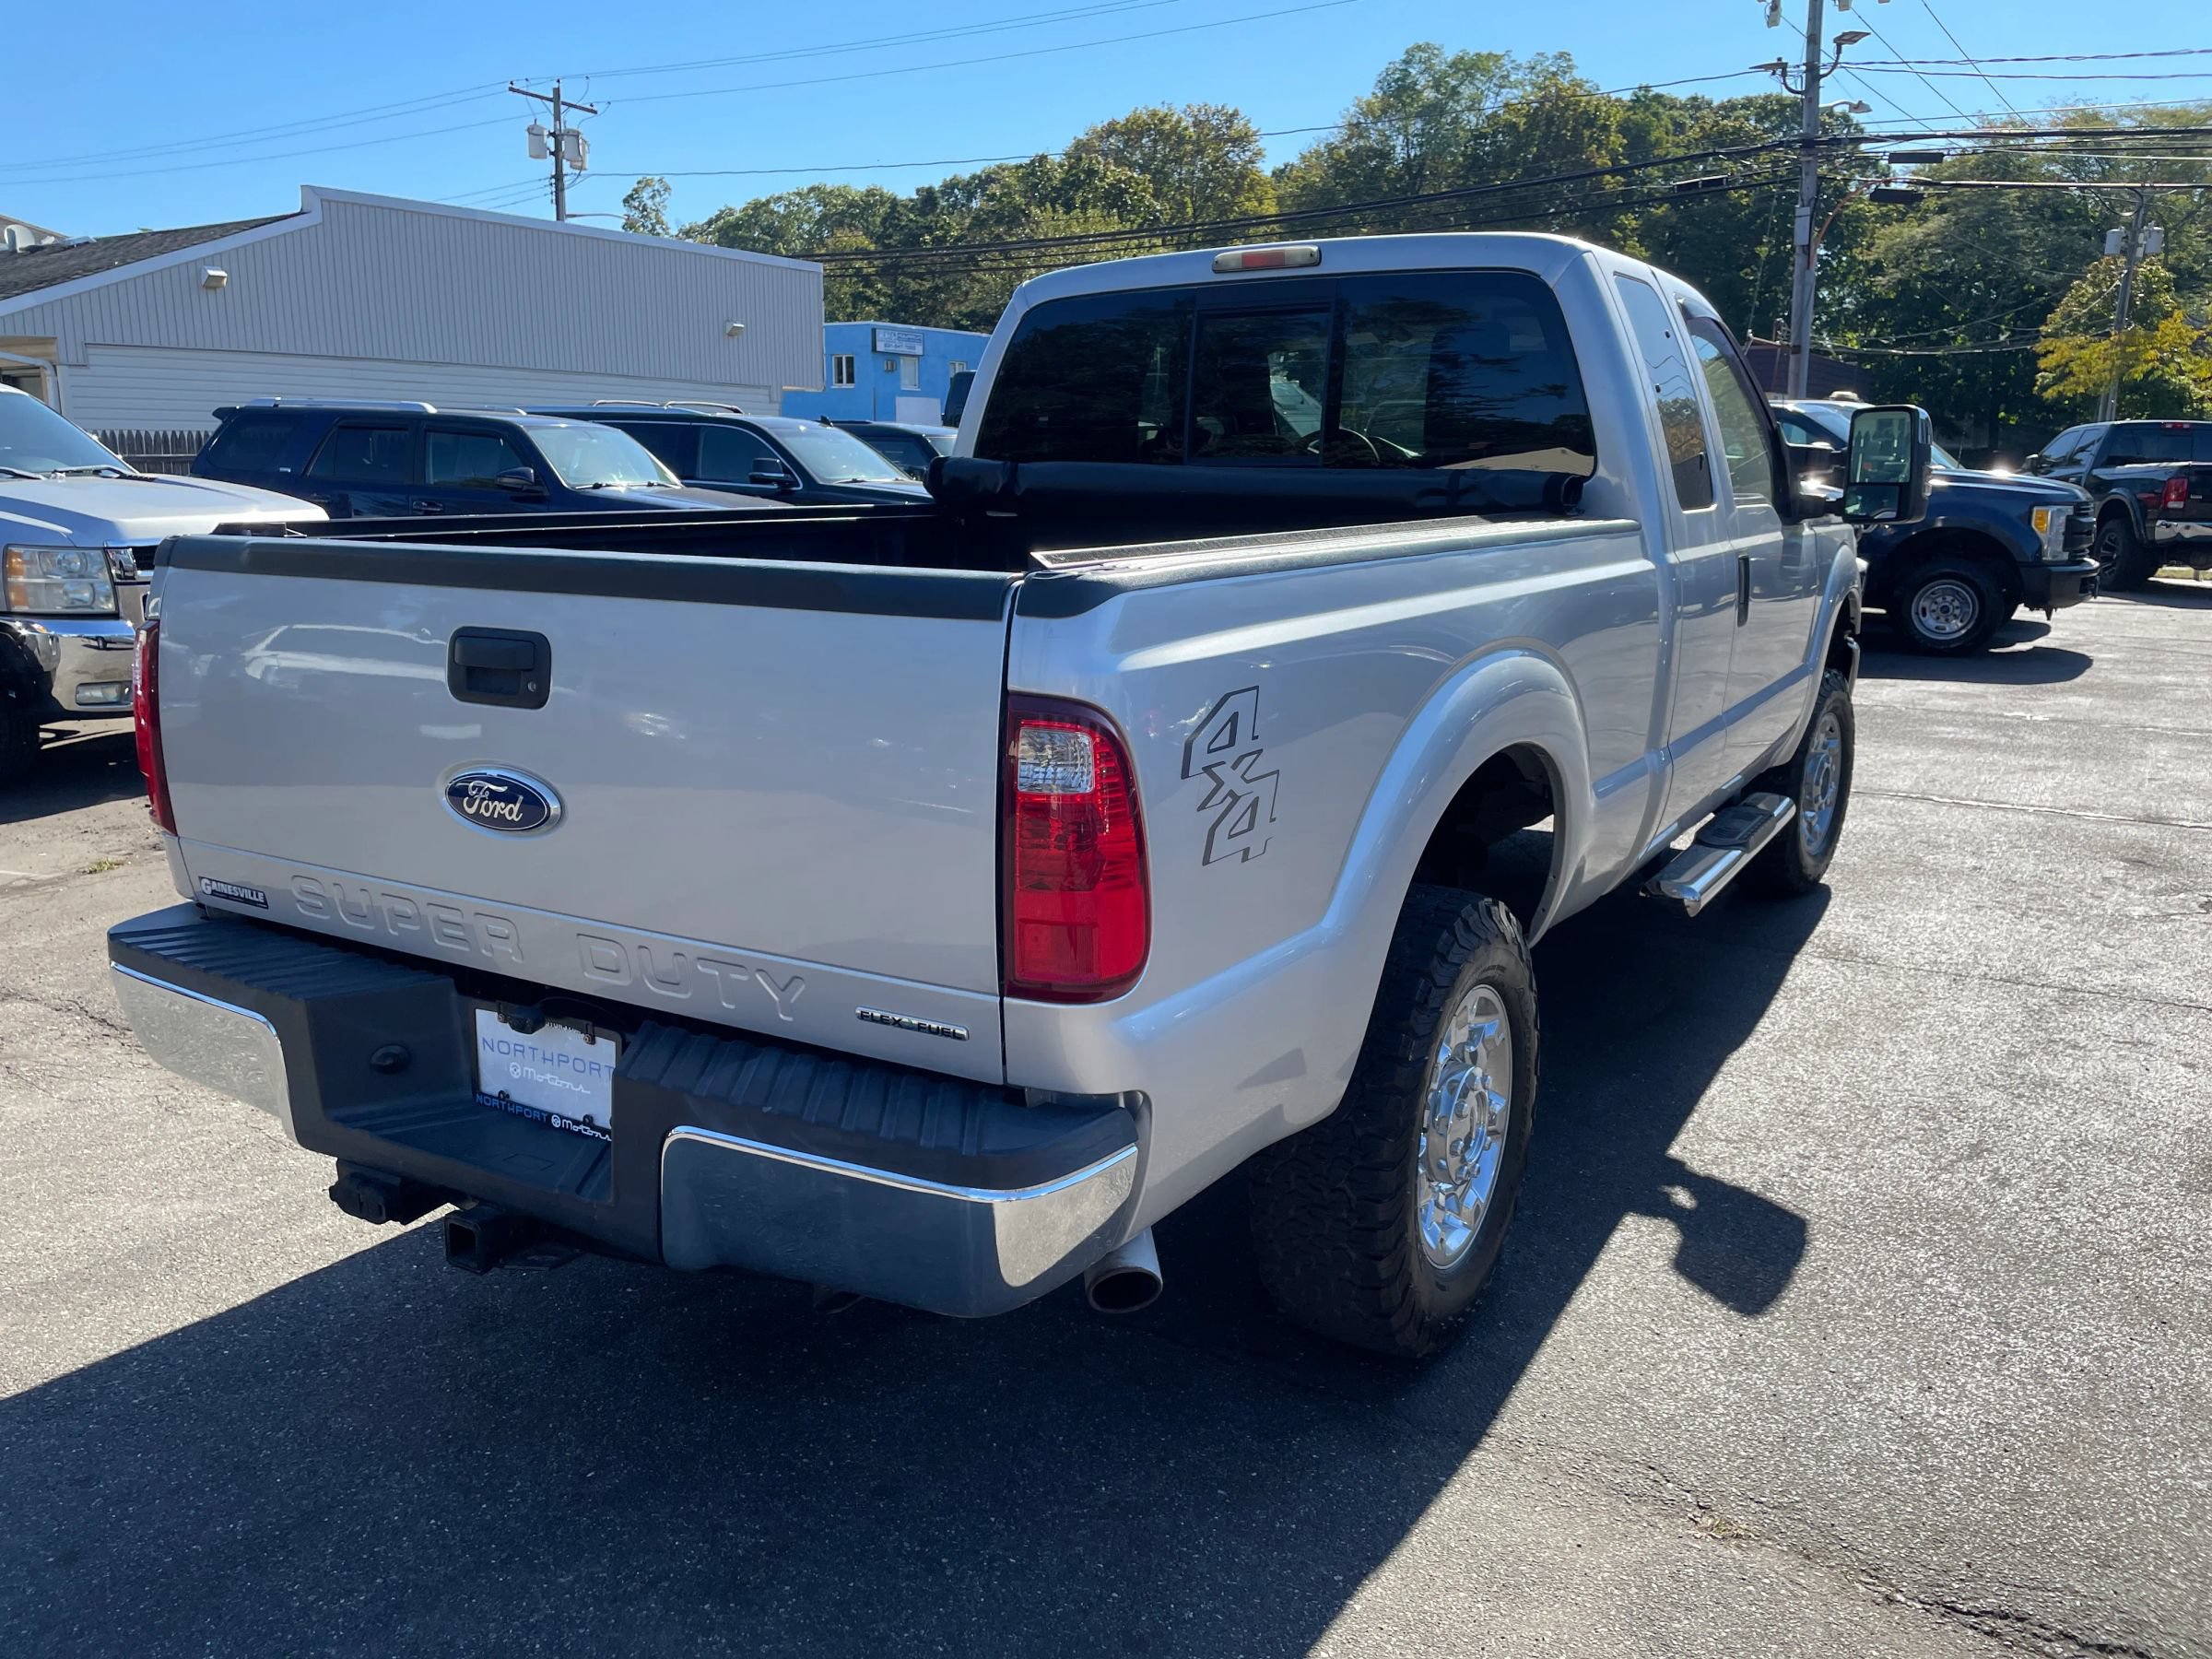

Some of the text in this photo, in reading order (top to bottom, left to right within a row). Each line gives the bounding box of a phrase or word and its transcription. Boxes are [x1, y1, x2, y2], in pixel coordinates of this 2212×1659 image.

[455, 780, 524, 821] Ford
[290, 875, 806, 1021] SUPER DUTY
[860, 1009, 966, 1041] FLEX FUEL
[483, 1039, 615, 1077] NORTHPORT
[477, 1095, 547, 1122] NORTHPORT
